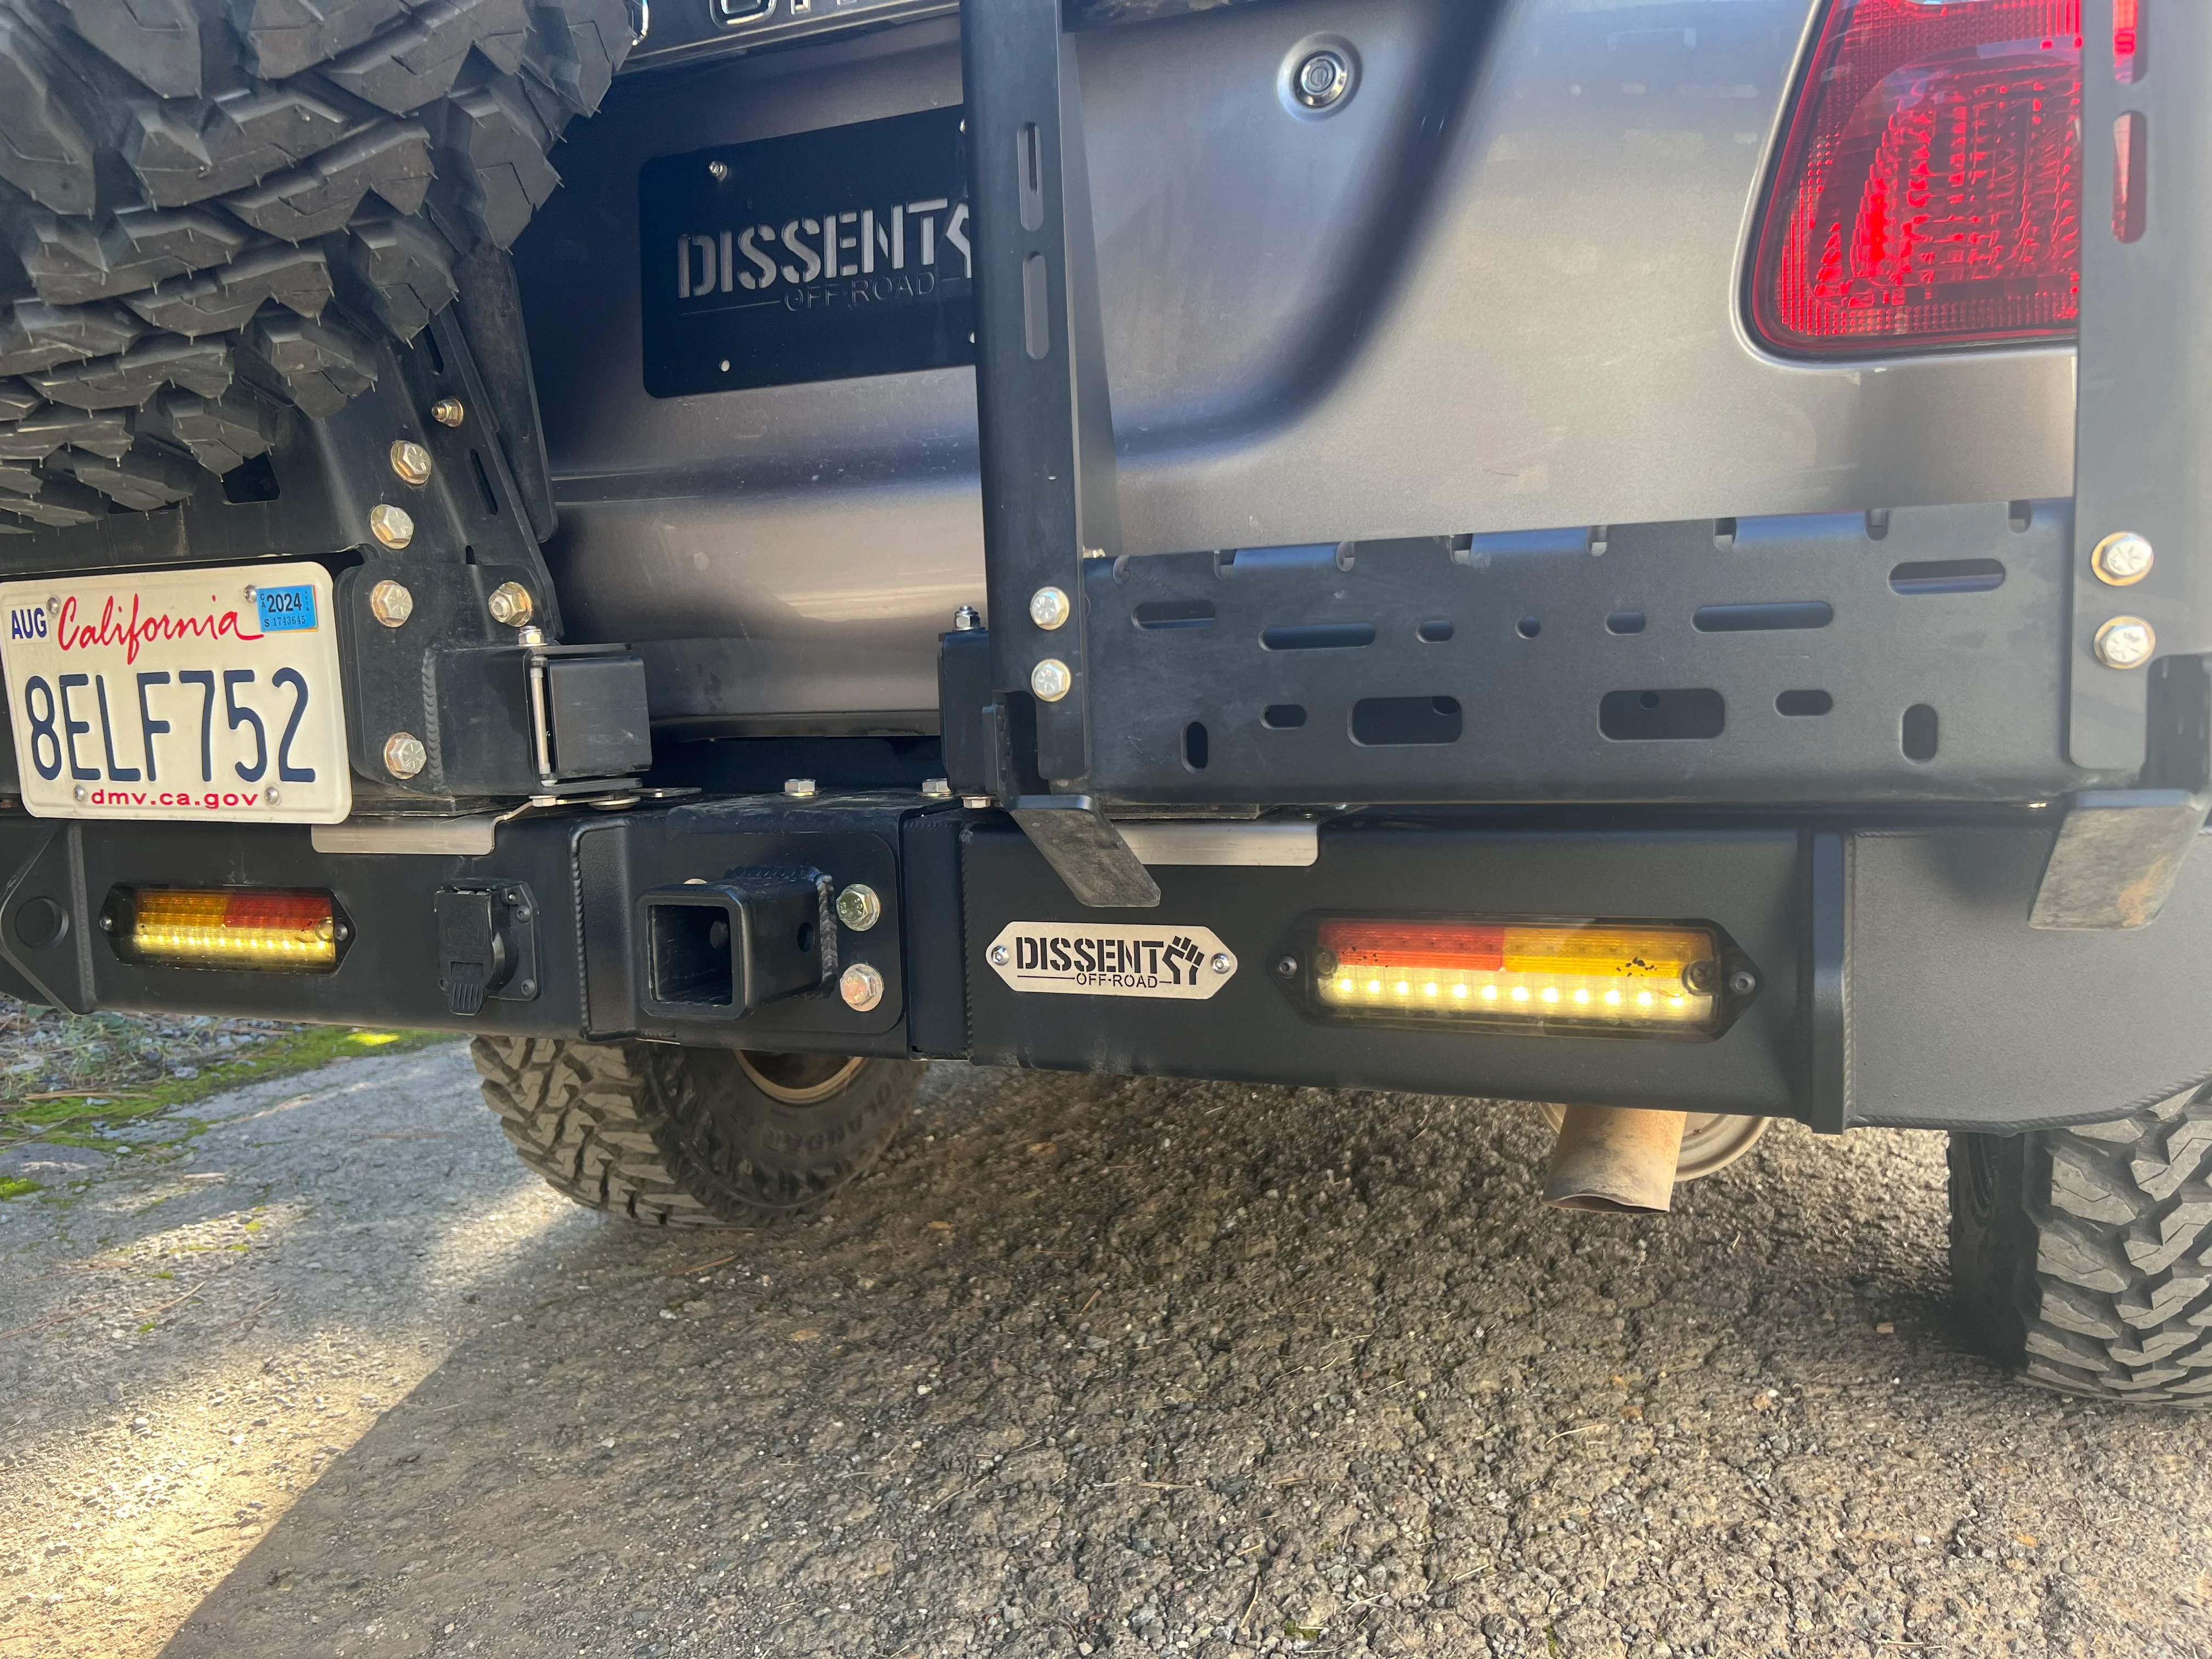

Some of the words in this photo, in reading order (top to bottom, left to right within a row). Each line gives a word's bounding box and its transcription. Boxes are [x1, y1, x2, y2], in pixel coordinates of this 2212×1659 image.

[678, 198, 948, 298] DISSENT
[267, 592, 302, 613] 2024
[11, 607, 47, 640] AUG
[58, 593, 264, 665] California
[25, 667, 316, 782] 8ELF752
[91, 788, 259, 809] dmv.ca.gov
[1015, 936, 1164, 974] DISSENT
